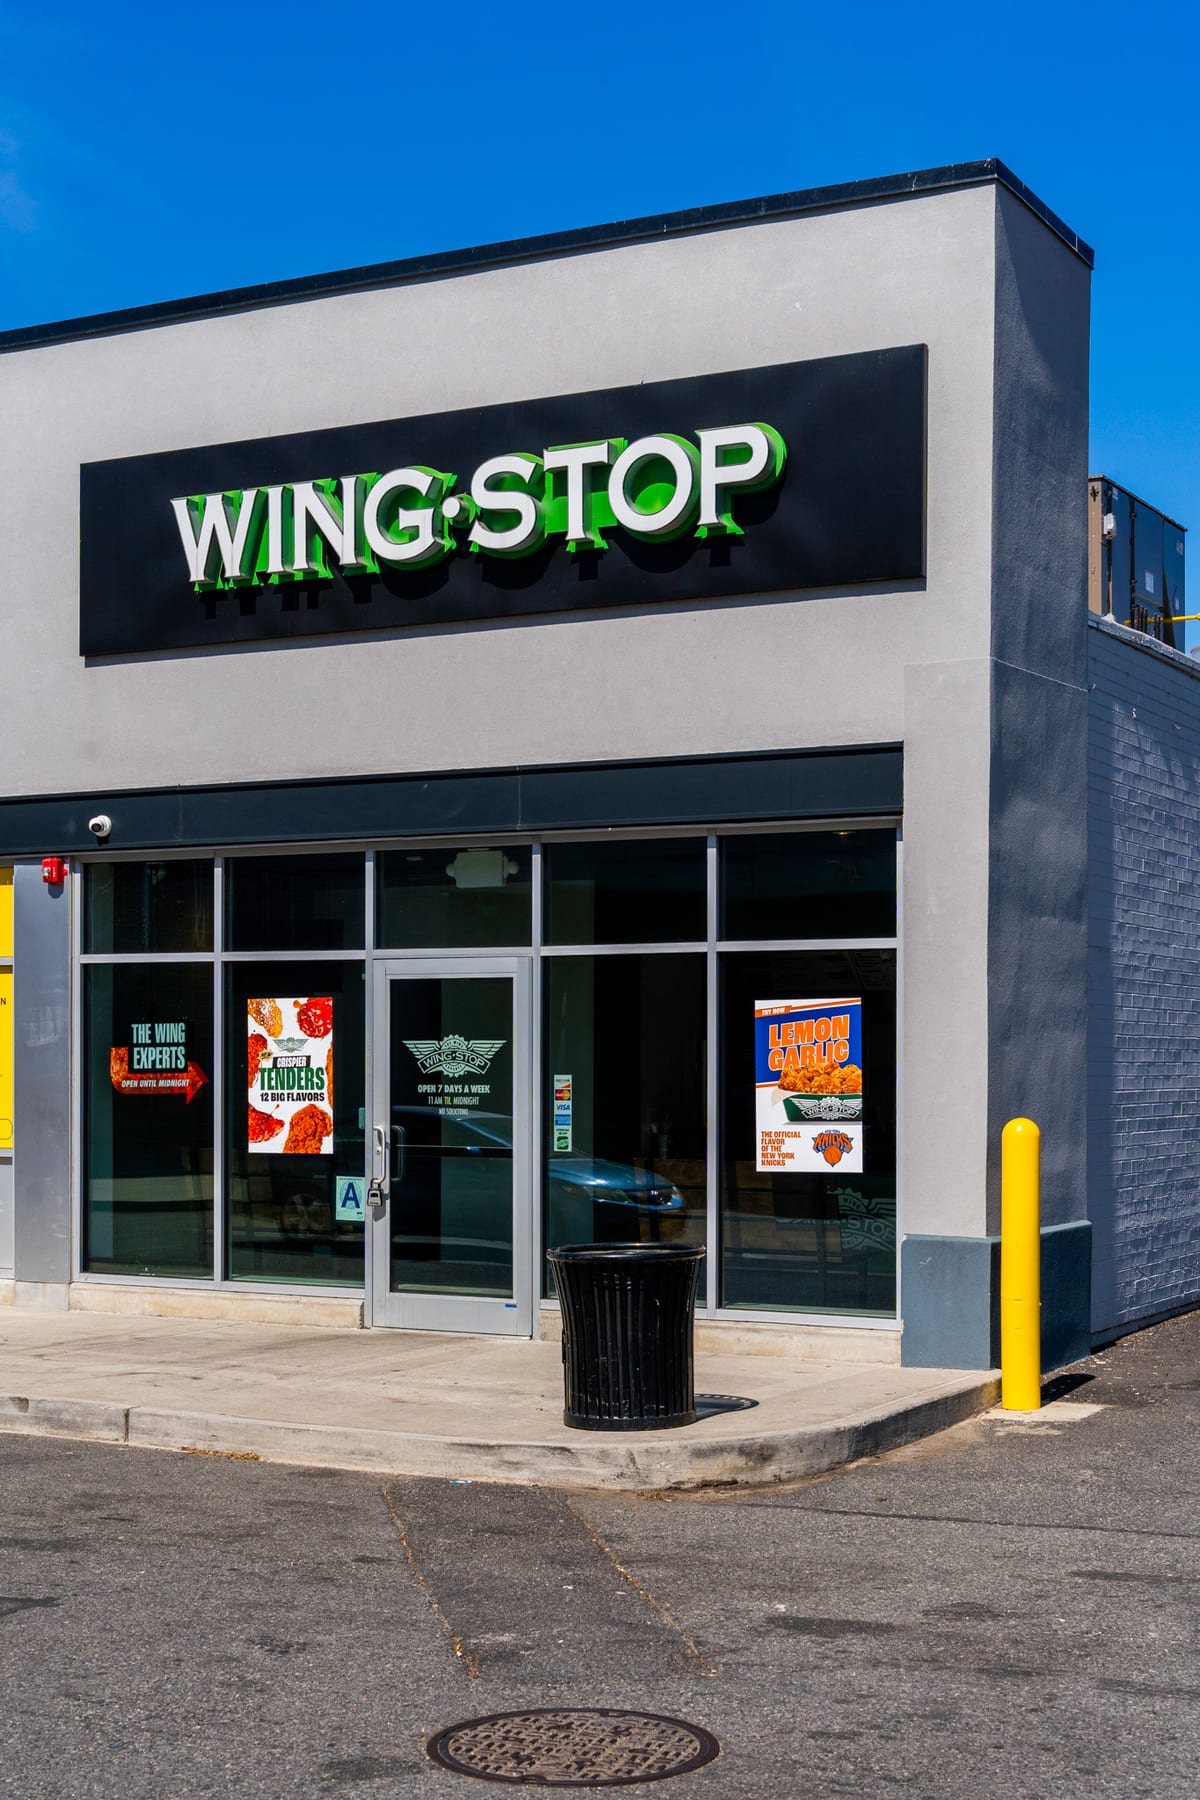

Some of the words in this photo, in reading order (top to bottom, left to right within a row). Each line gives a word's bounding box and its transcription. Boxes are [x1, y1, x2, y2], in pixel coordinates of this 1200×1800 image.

[761, 1008, 771, 1016] TRY
[772, 1007, 786, 1015] NOW
[131, 1023, 152, 1044] THE
[154, 1022, 186, 1044] WING
[769, 1014, 850, 1049] LEMON
[133, 1046, 186, 1069] EXPERTS
[276, 1056, 307, 1067] CRISPIER
[768, 1039, 849, 1071] GARLIC
[121, 1080, 138, 1088] OPEN
[158, 1079, 190, 1087] MIDNIGHT
[259, 1067, 325, 1091] TENDERS
[260, 1092, 269, 1102] 12
[271, 1092, 286, 1102] BIG
[287, 1092, 325, 1102] FLAVORS
[417, 1084, 437, 1093] OPEN
[437, 1084, 443, 1093] 7
[444, 1084, 463, 1093] DAYS
[463, 1085, 470, 1093] A
[470, 1084, 491, 1093] WEEK
[453, 1096, 480, 1105] MIDNIGHT
[812, 1132, 853, 1150] KNICKS
[341, 1182, 360, 1208] A
